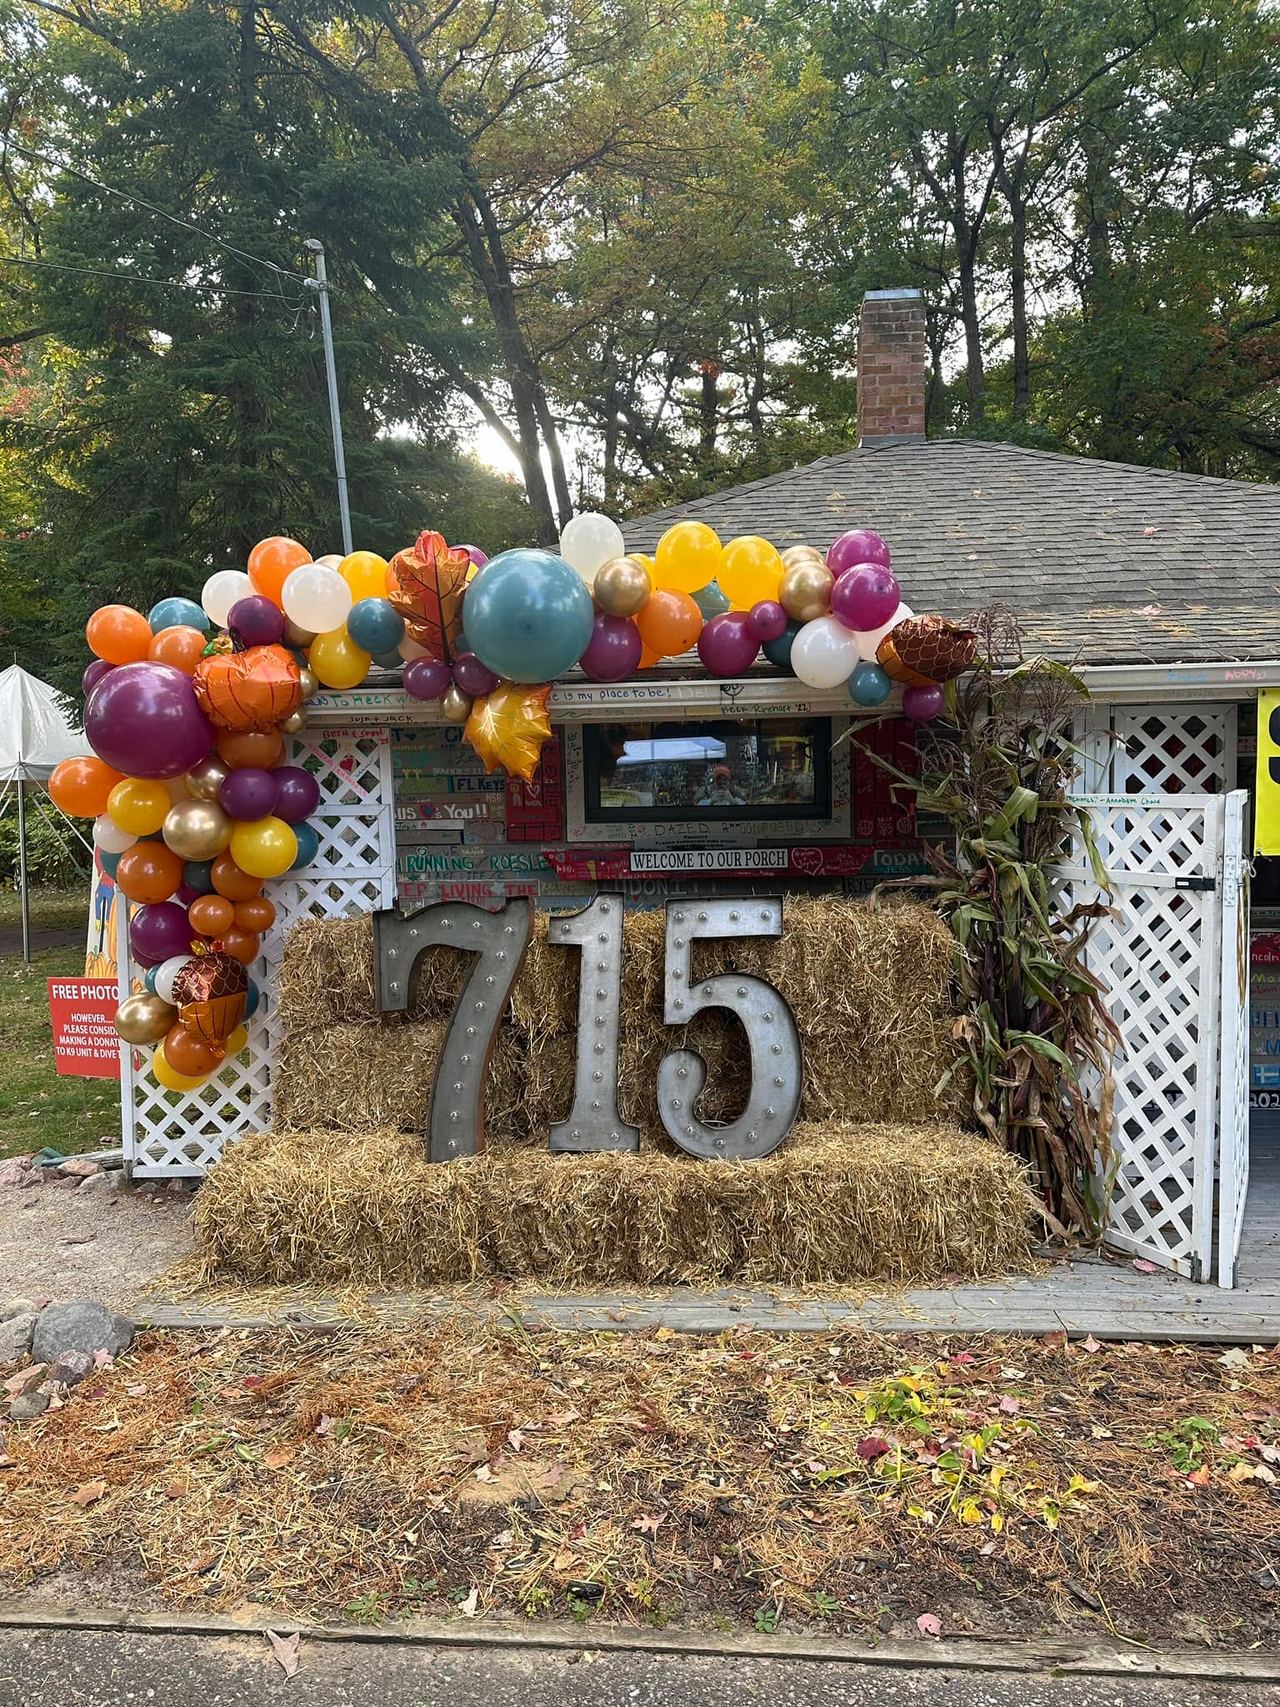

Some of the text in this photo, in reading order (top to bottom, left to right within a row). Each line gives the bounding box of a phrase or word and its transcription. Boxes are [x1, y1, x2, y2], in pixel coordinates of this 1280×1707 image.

[633, 854, 695, 869] WELCOME
[697, 853, 714, 868] TO
[717, 852, 743, 867] OUR
[745, 851, 786, 866] PORCH
[52, 984, 79, 1000] FREE
[63, 1024, 88, 1034] PLEASE
[59, 1035, 87, 1046] MAKING
[87, 1037, 94, 1046] A
[56, 1046, 66, 1056] TO
[66, 1047, 76, 1056] K9
[76, 1048, 92, 1057] UNIT
[99, 1049, 117, 1059] DIVE
